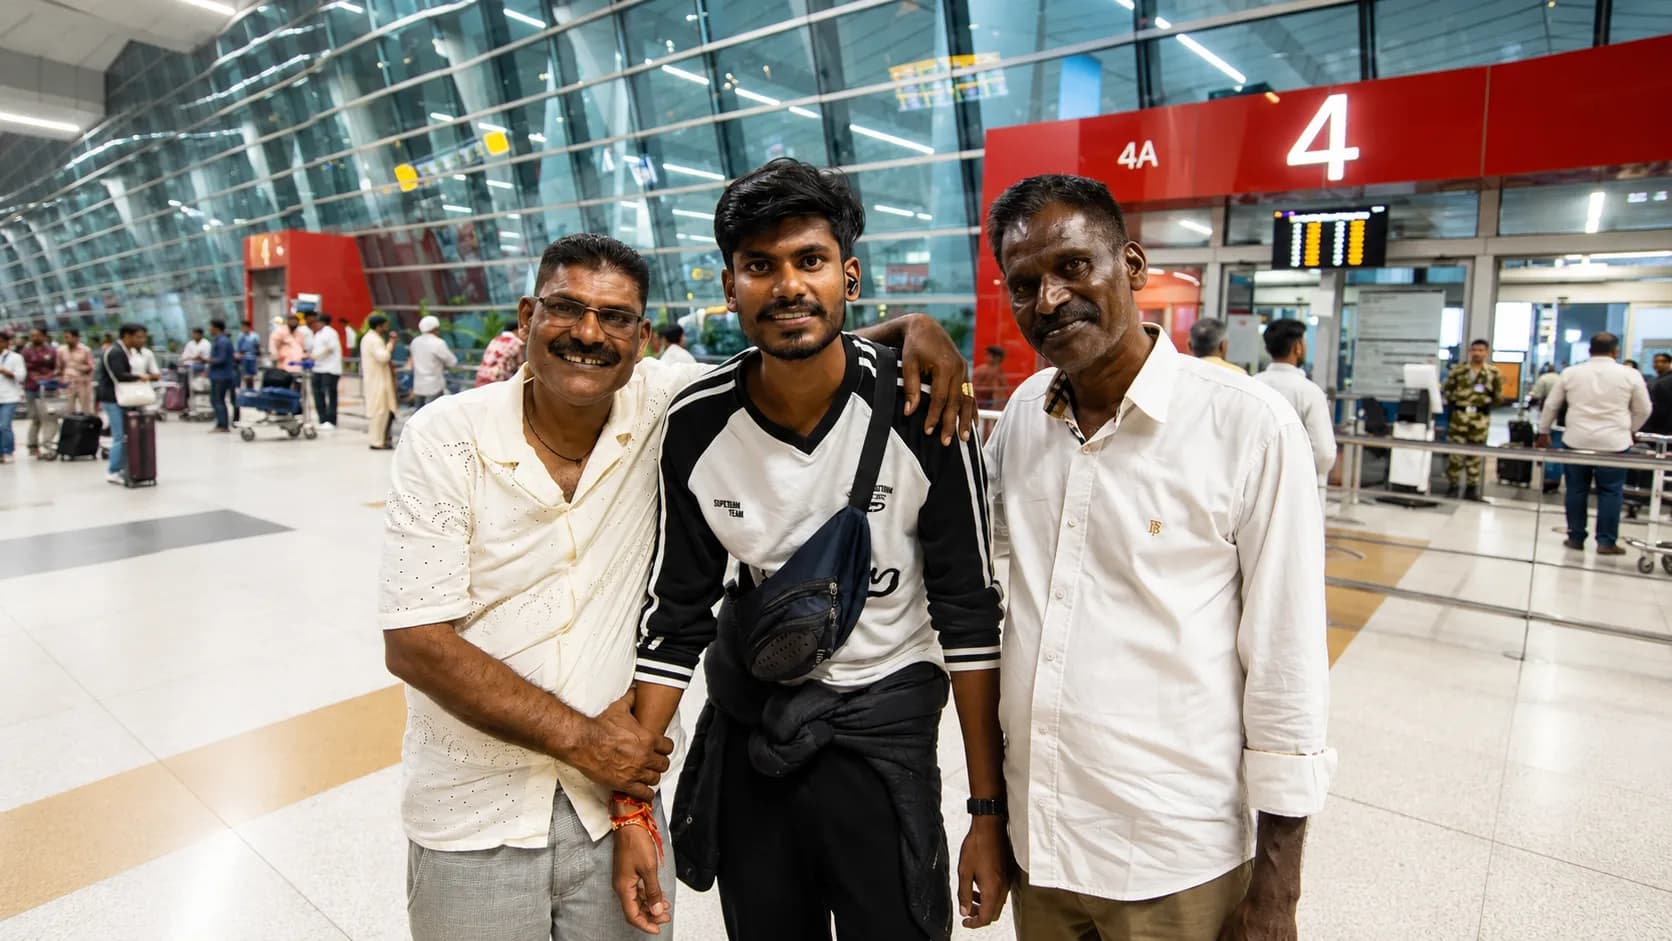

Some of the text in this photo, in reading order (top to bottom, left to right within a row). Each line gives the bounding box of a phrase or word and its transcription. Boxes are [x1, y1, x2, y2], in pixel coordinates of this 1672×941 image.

[1286, 93, 1360, 181] 4
[1117, 139, 1159, 170] 4A
[728, 509, 744, 518] TEAM
